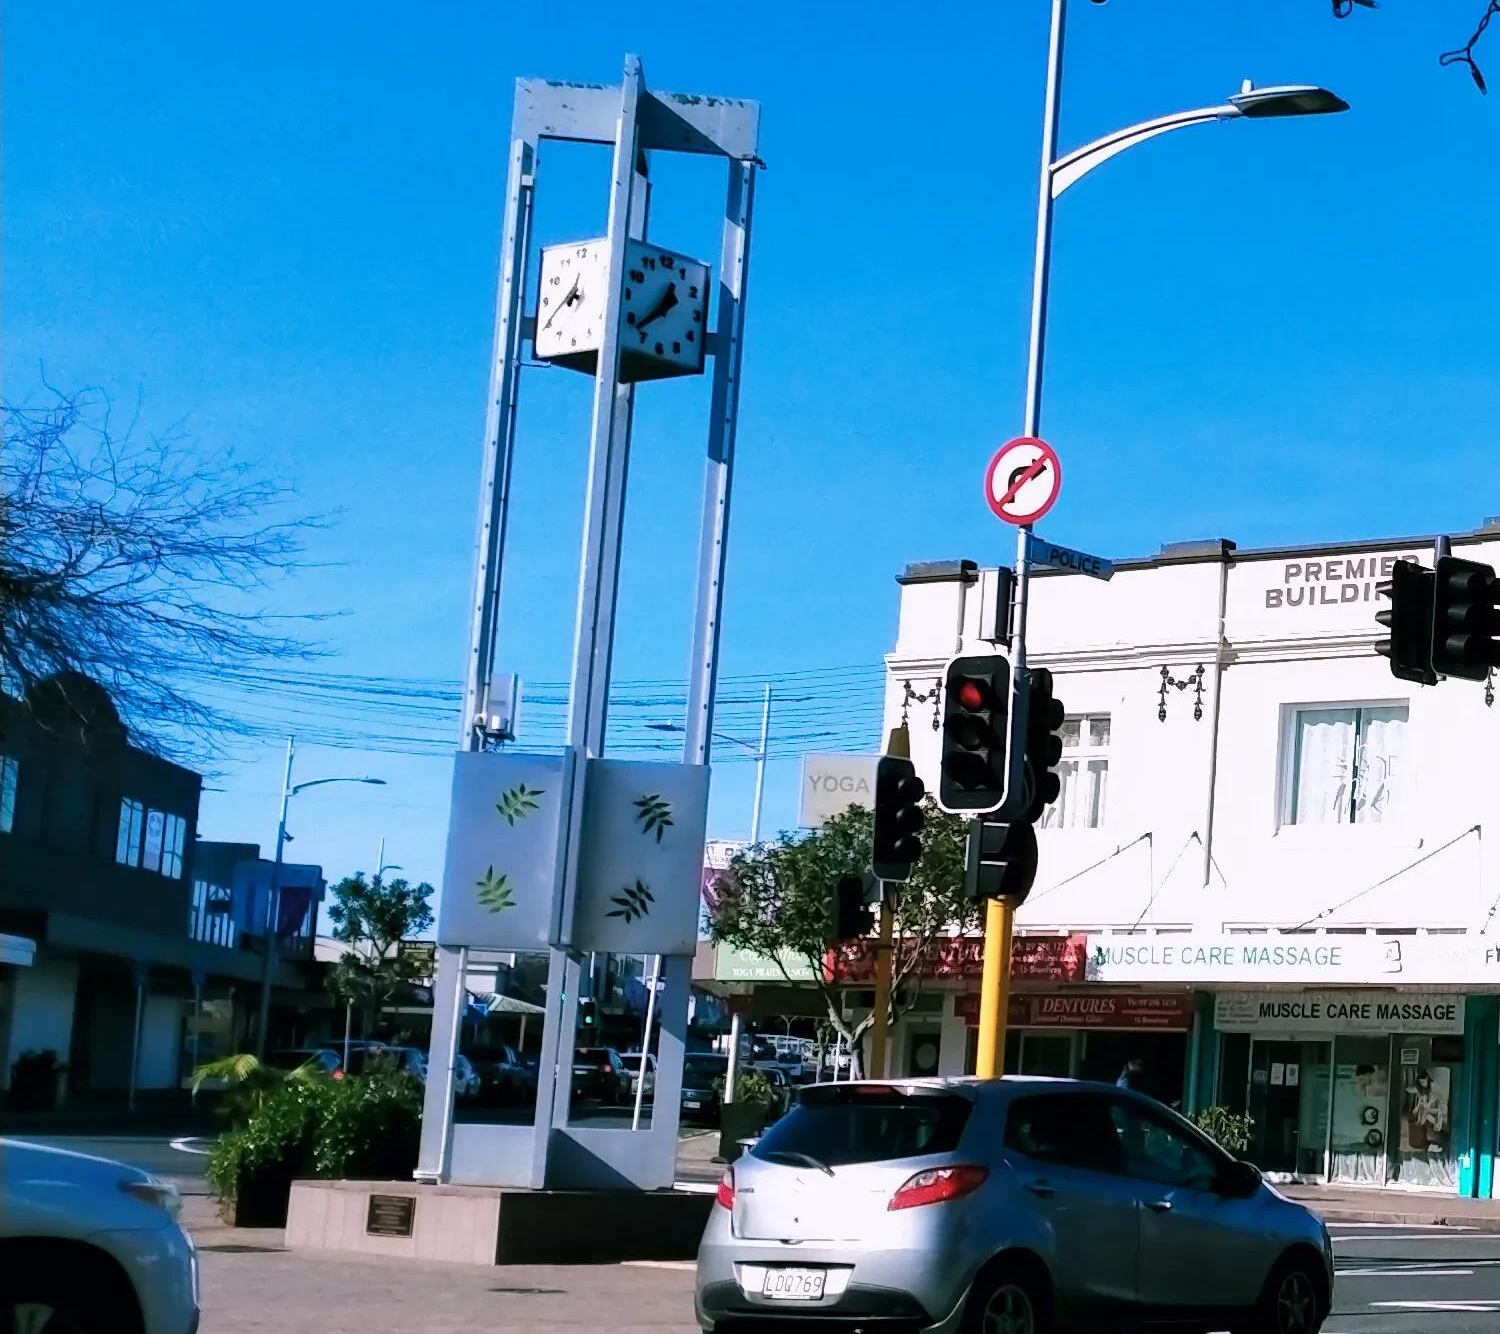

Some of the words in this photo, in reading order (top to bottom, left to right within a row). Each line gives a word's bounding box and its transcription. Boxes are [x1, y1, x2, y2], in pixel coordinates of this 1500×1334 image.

[1049, 547, 1101, 575] POLICE
[1265, 582, 1382, 609] BUILDI
[808, 774, 870, 794] YOGA
[1098, 946, 1174, 967] MUSCLE
[1181, 946, 1235, 966] CARE
[1243, 946, 1342, 966] MASSAGE
[1043, 997, 1117, 1014] DENTURES
[1259, 1002, 1321, 1019] MUSCLE
[1327, 1003, 1371, 1019] CARE
[1377, 1004, 1456, 1021] MASSAGE
